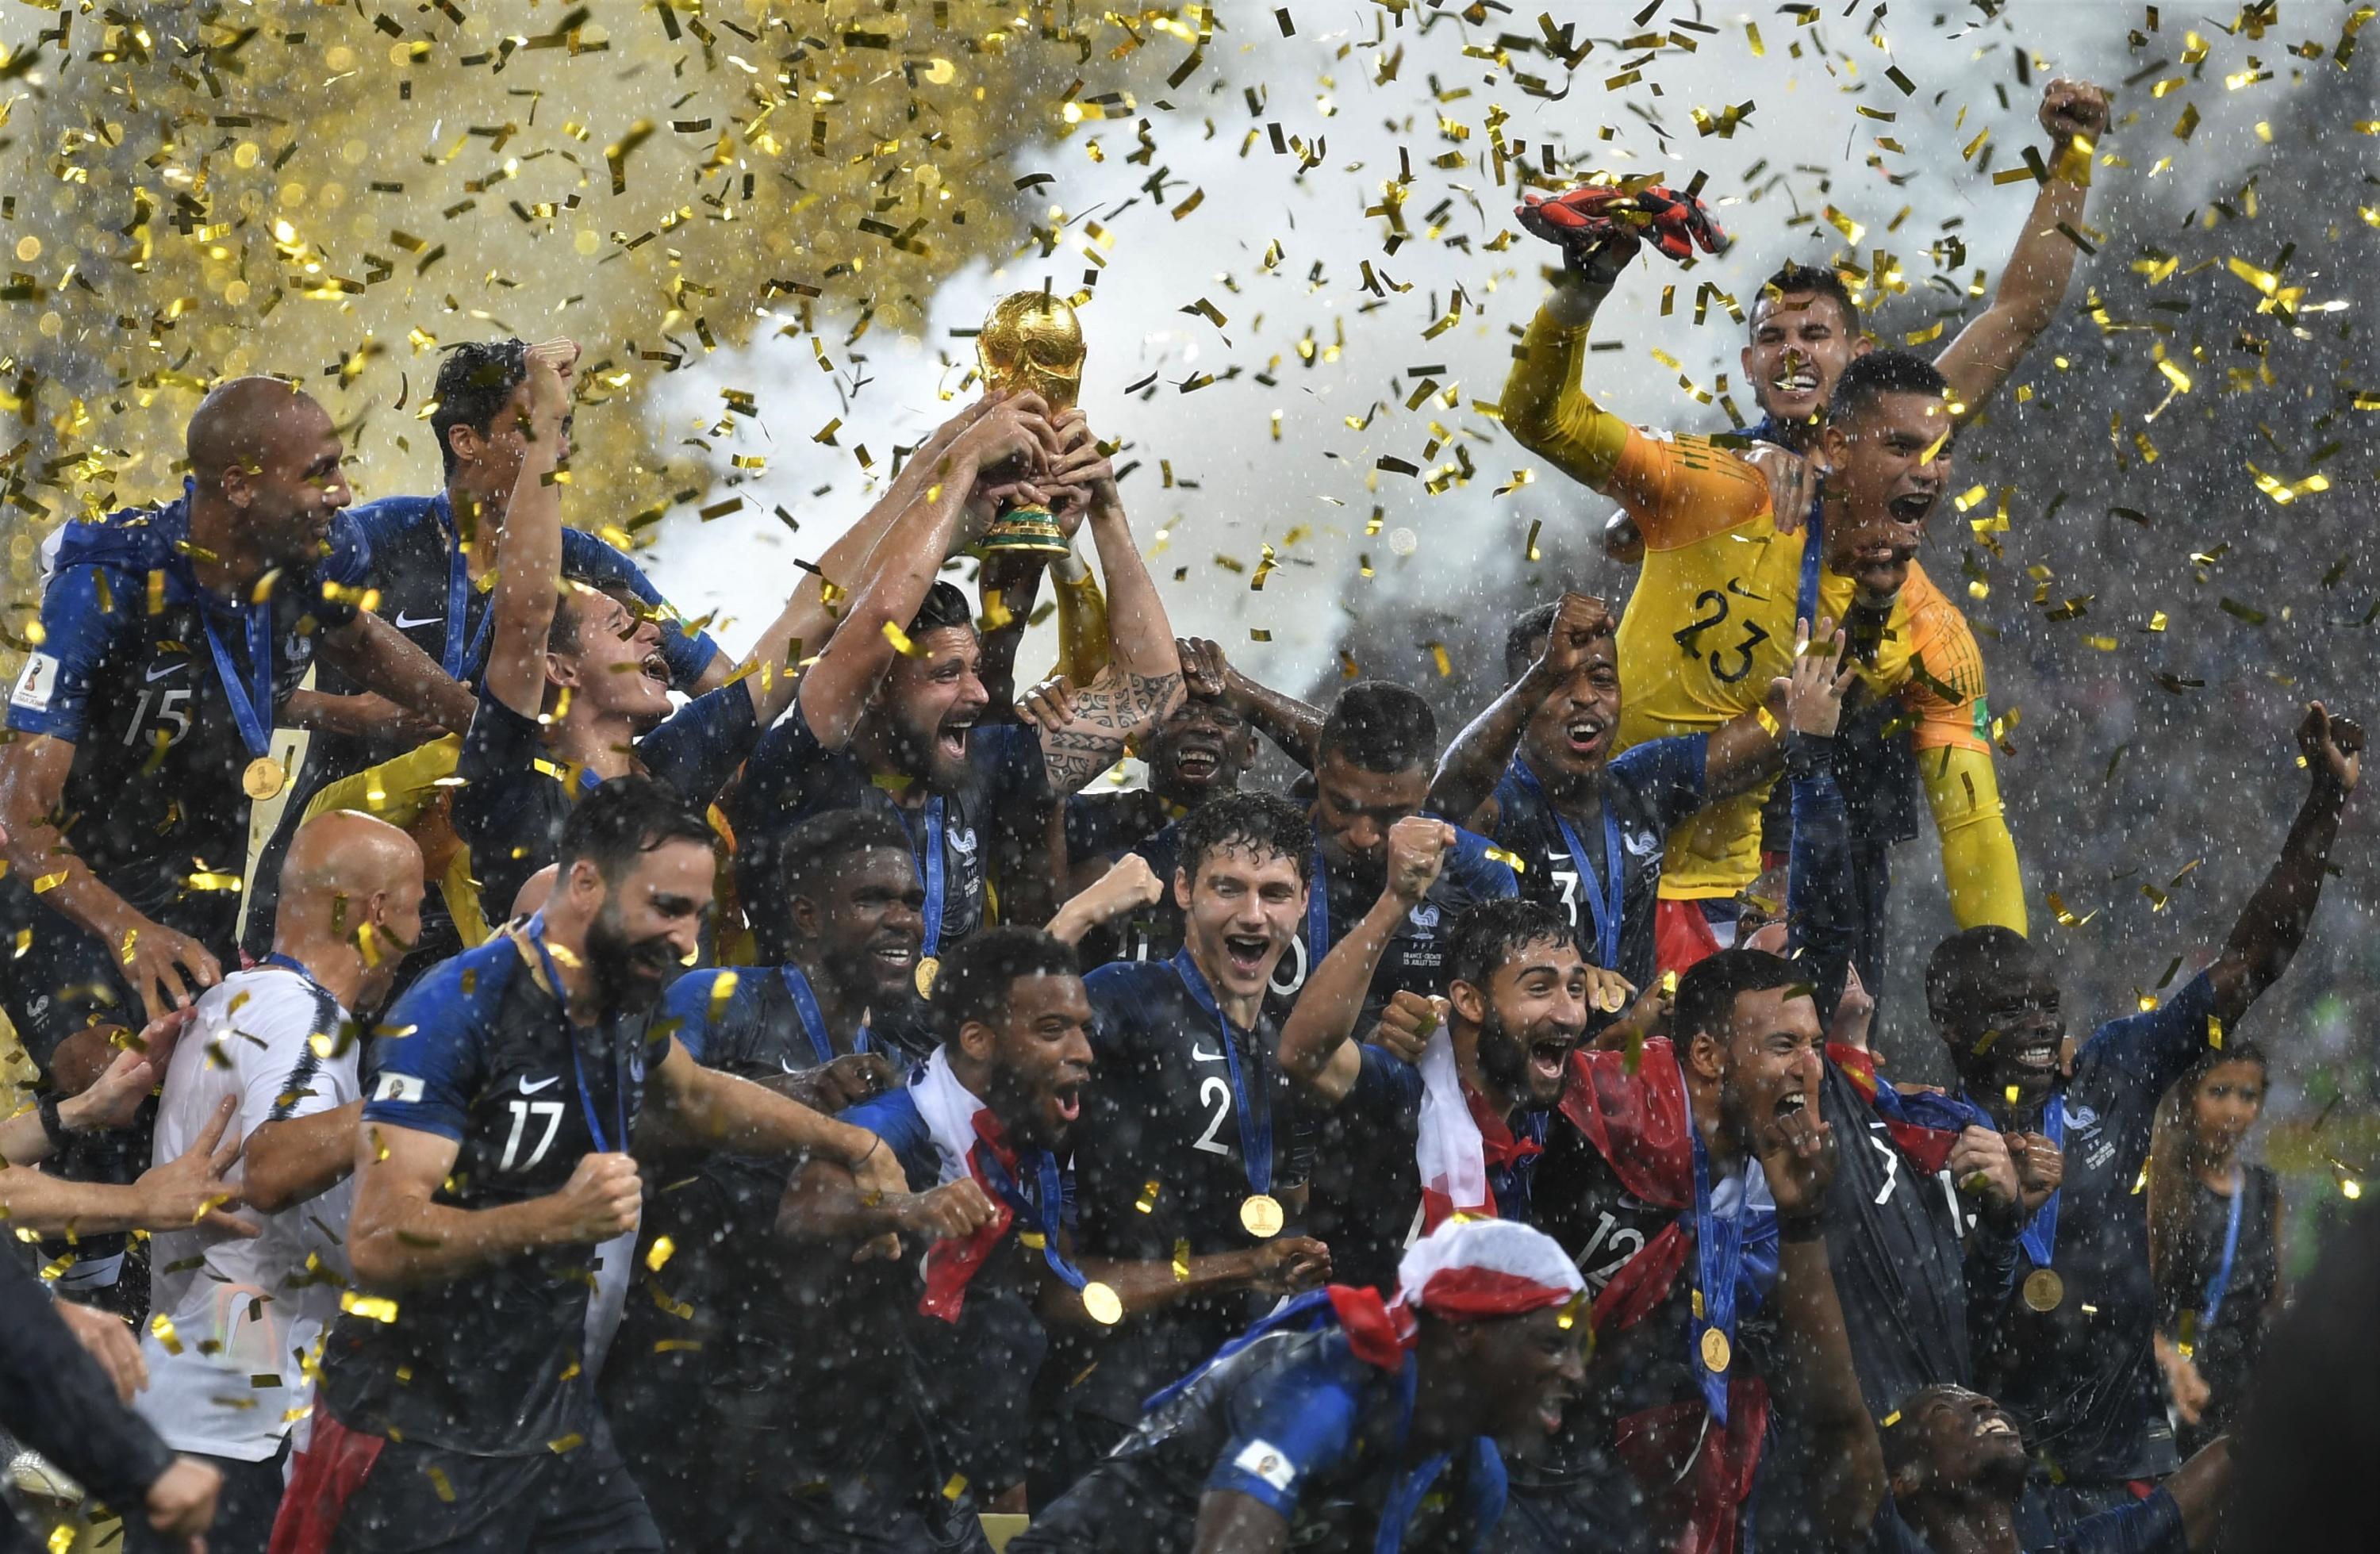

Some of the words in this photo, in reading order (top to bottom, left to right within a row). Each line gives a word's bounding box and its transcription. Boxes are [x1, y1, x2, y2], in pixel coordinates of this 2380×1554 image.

[1672, 589, 1769, 684] 23
[122, 689, 193, 747] 15
[498, 1100, 566, 1173] 17
[1192, 1075, 1232, 1156] 2
[1574, 1210, 1645, 1289] 12
